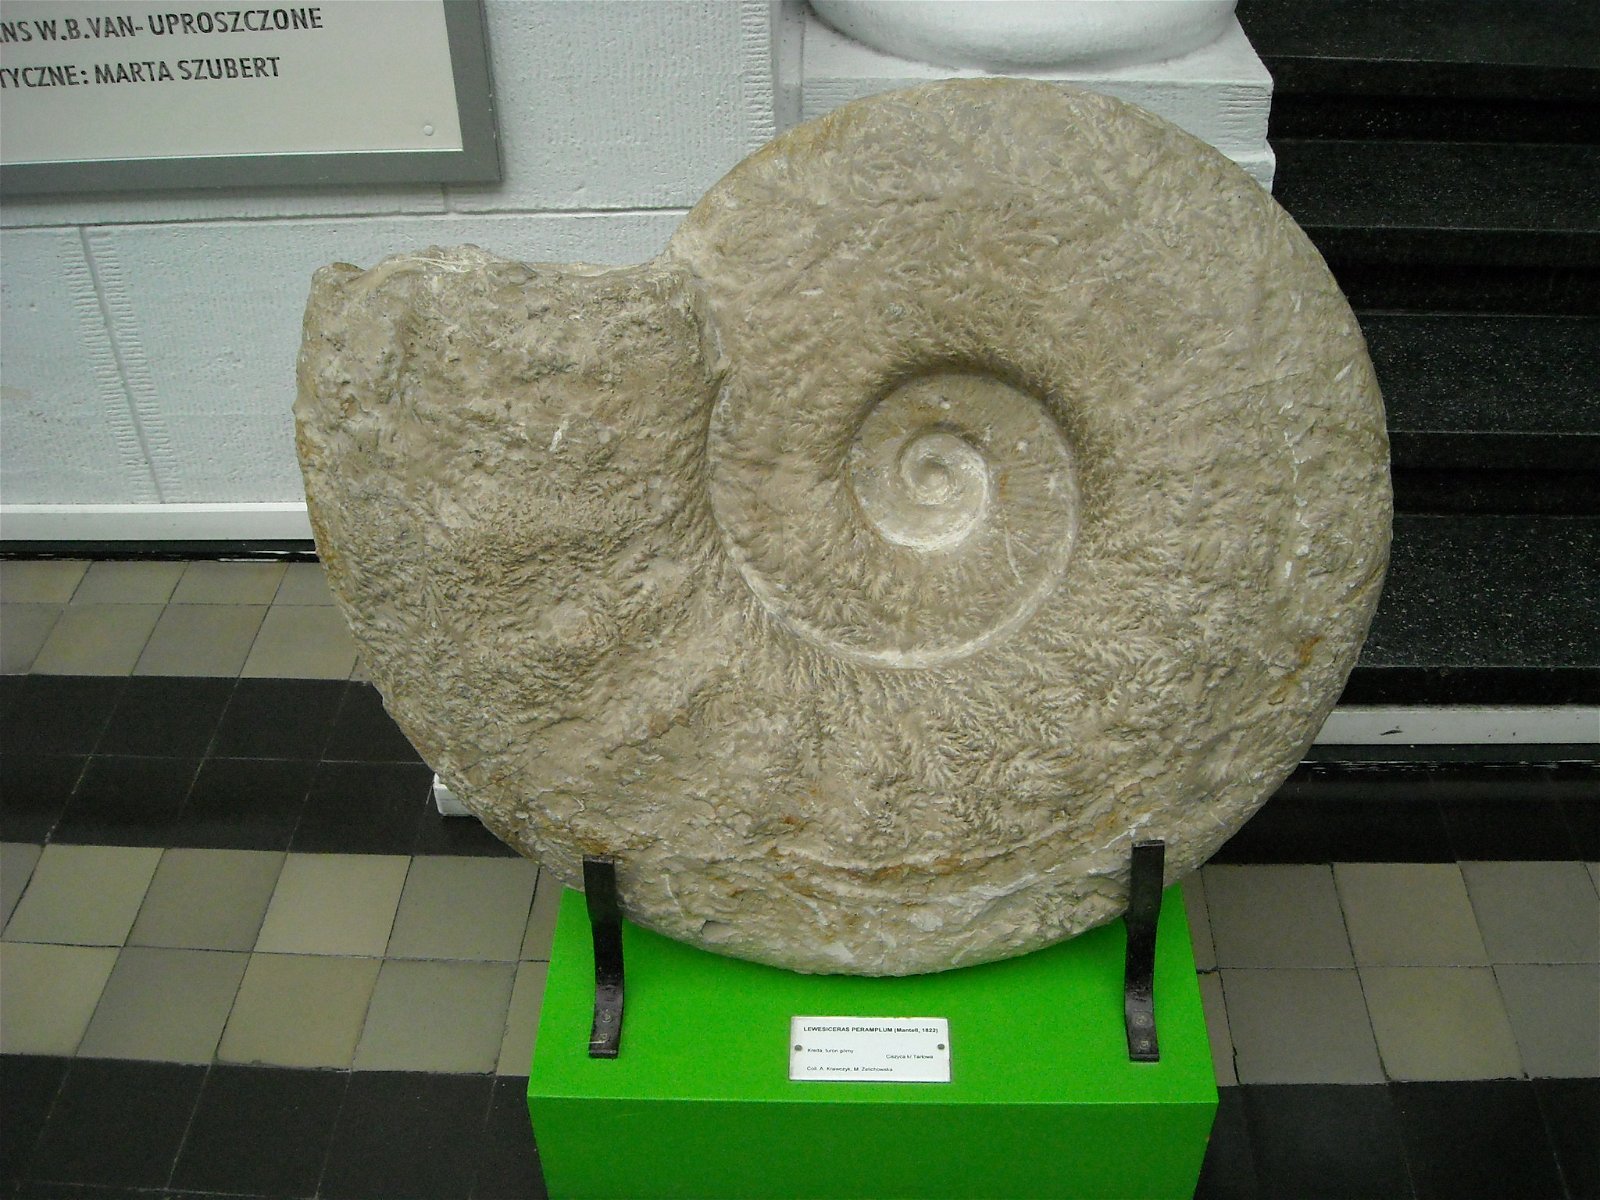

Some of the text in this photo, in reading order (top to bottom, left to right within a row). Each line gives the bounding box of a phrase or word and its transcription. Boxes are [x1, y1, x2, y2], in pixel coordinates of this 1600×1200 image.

[0, 21, 32, 43] NS
[148, 7, 323, 36] UPROSZCZONE
[94, 60, 175, 85] MARTA
[177, 56, 280, 81] SZUBERT
